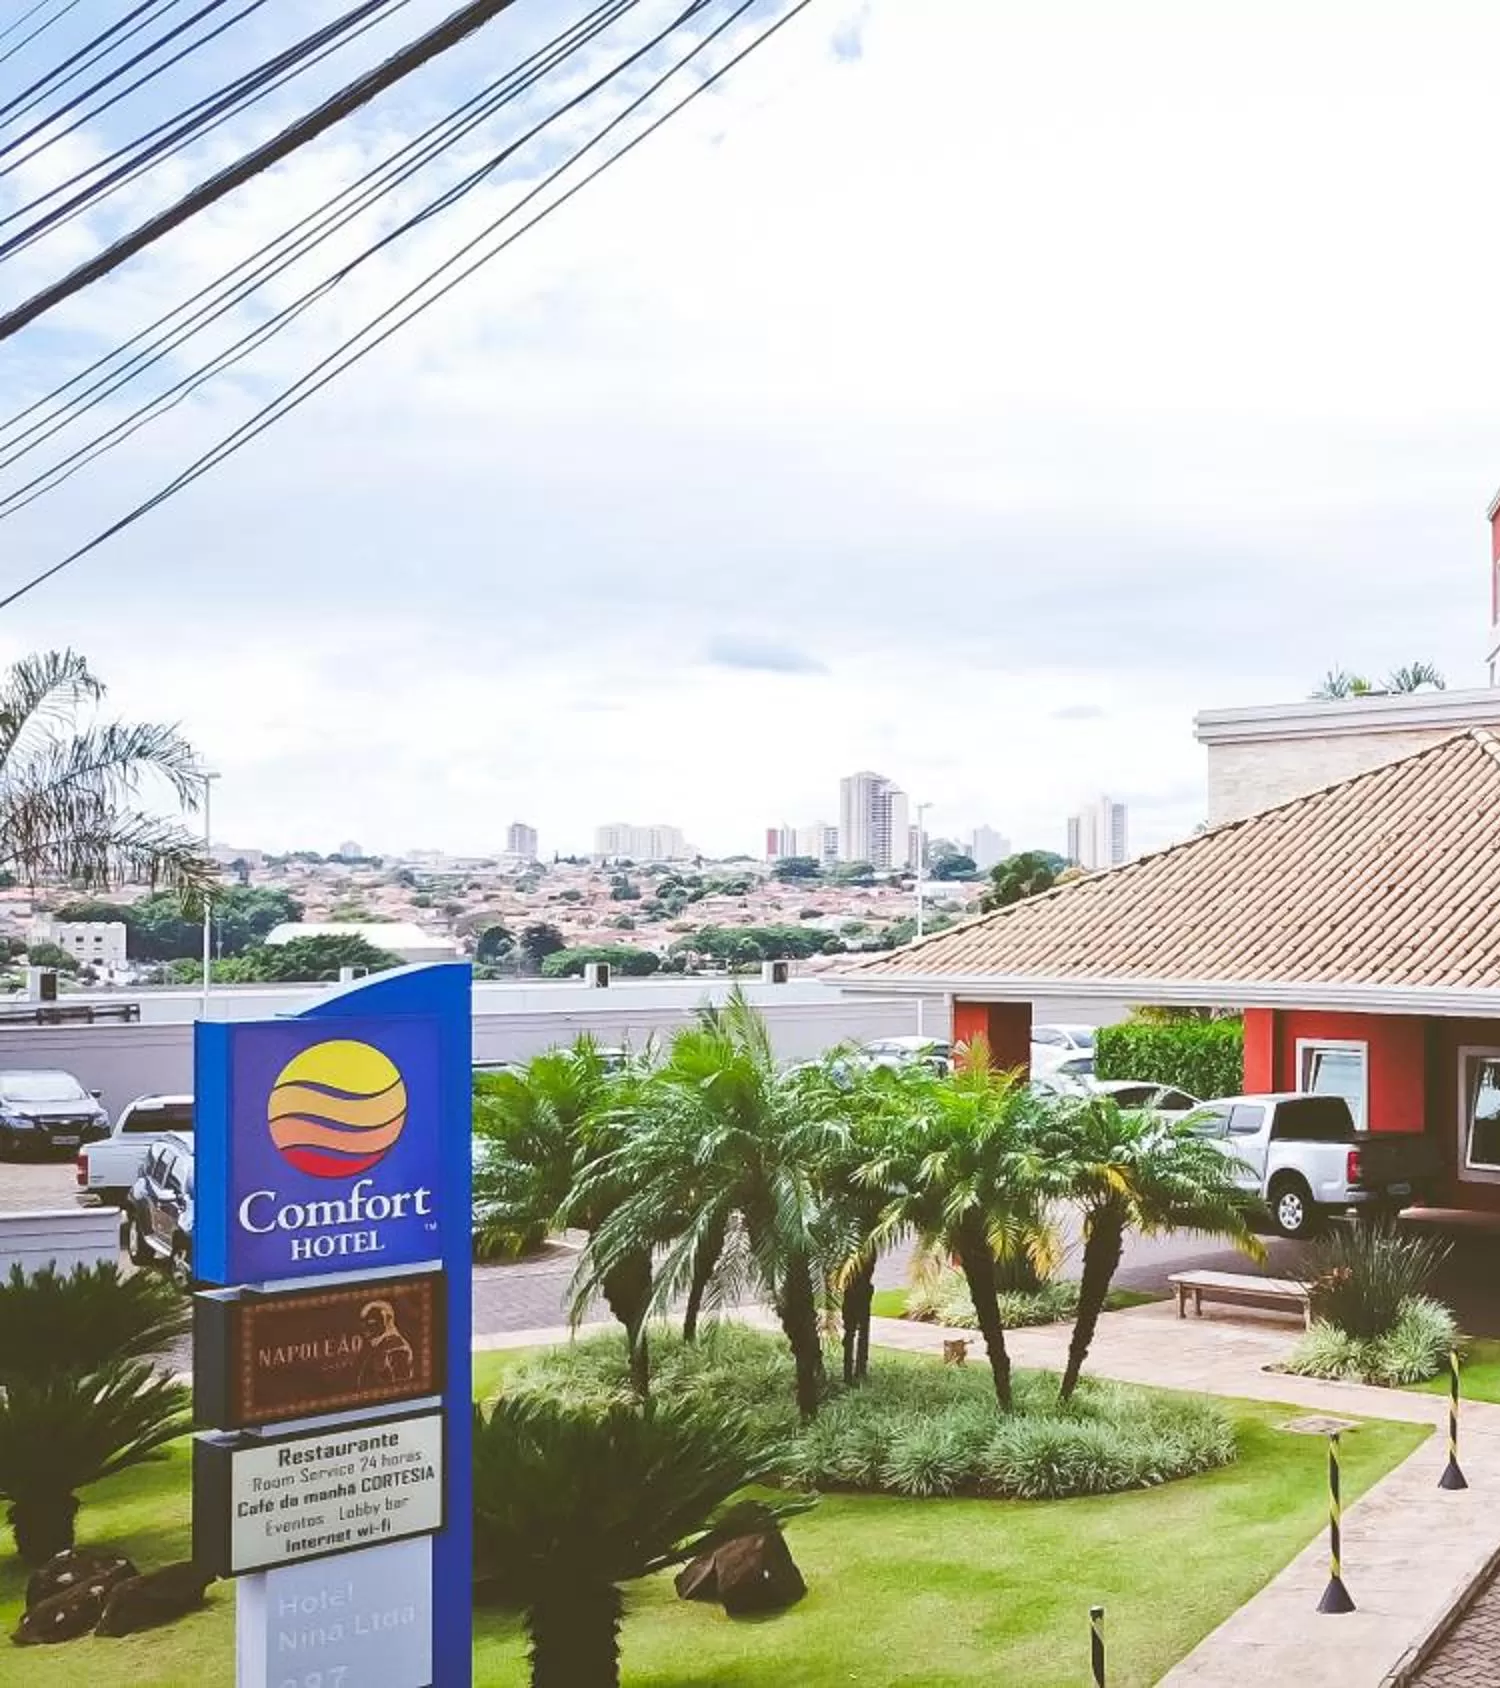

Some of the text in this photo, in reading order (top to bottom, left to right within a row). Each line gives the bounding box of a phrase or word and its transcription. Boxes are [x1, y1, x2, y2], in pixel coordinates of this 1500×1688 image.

[238, 1179, 431, 1234] Comfort
[290, 1230, 385, 1261] HOTEL
[278, 1433, 399, 1468] Restaurante
[252, 1475, 295, 1493] Room
[300, 1463, 355, 1483] Service
[360, 1455, 377, 1472] 24
[361, 1464, 435, 1493] CORTESIA
[265, 1496, 410, 1537] Eventos Lobby bar
[278, 1581, 354, 1617] Hotel
